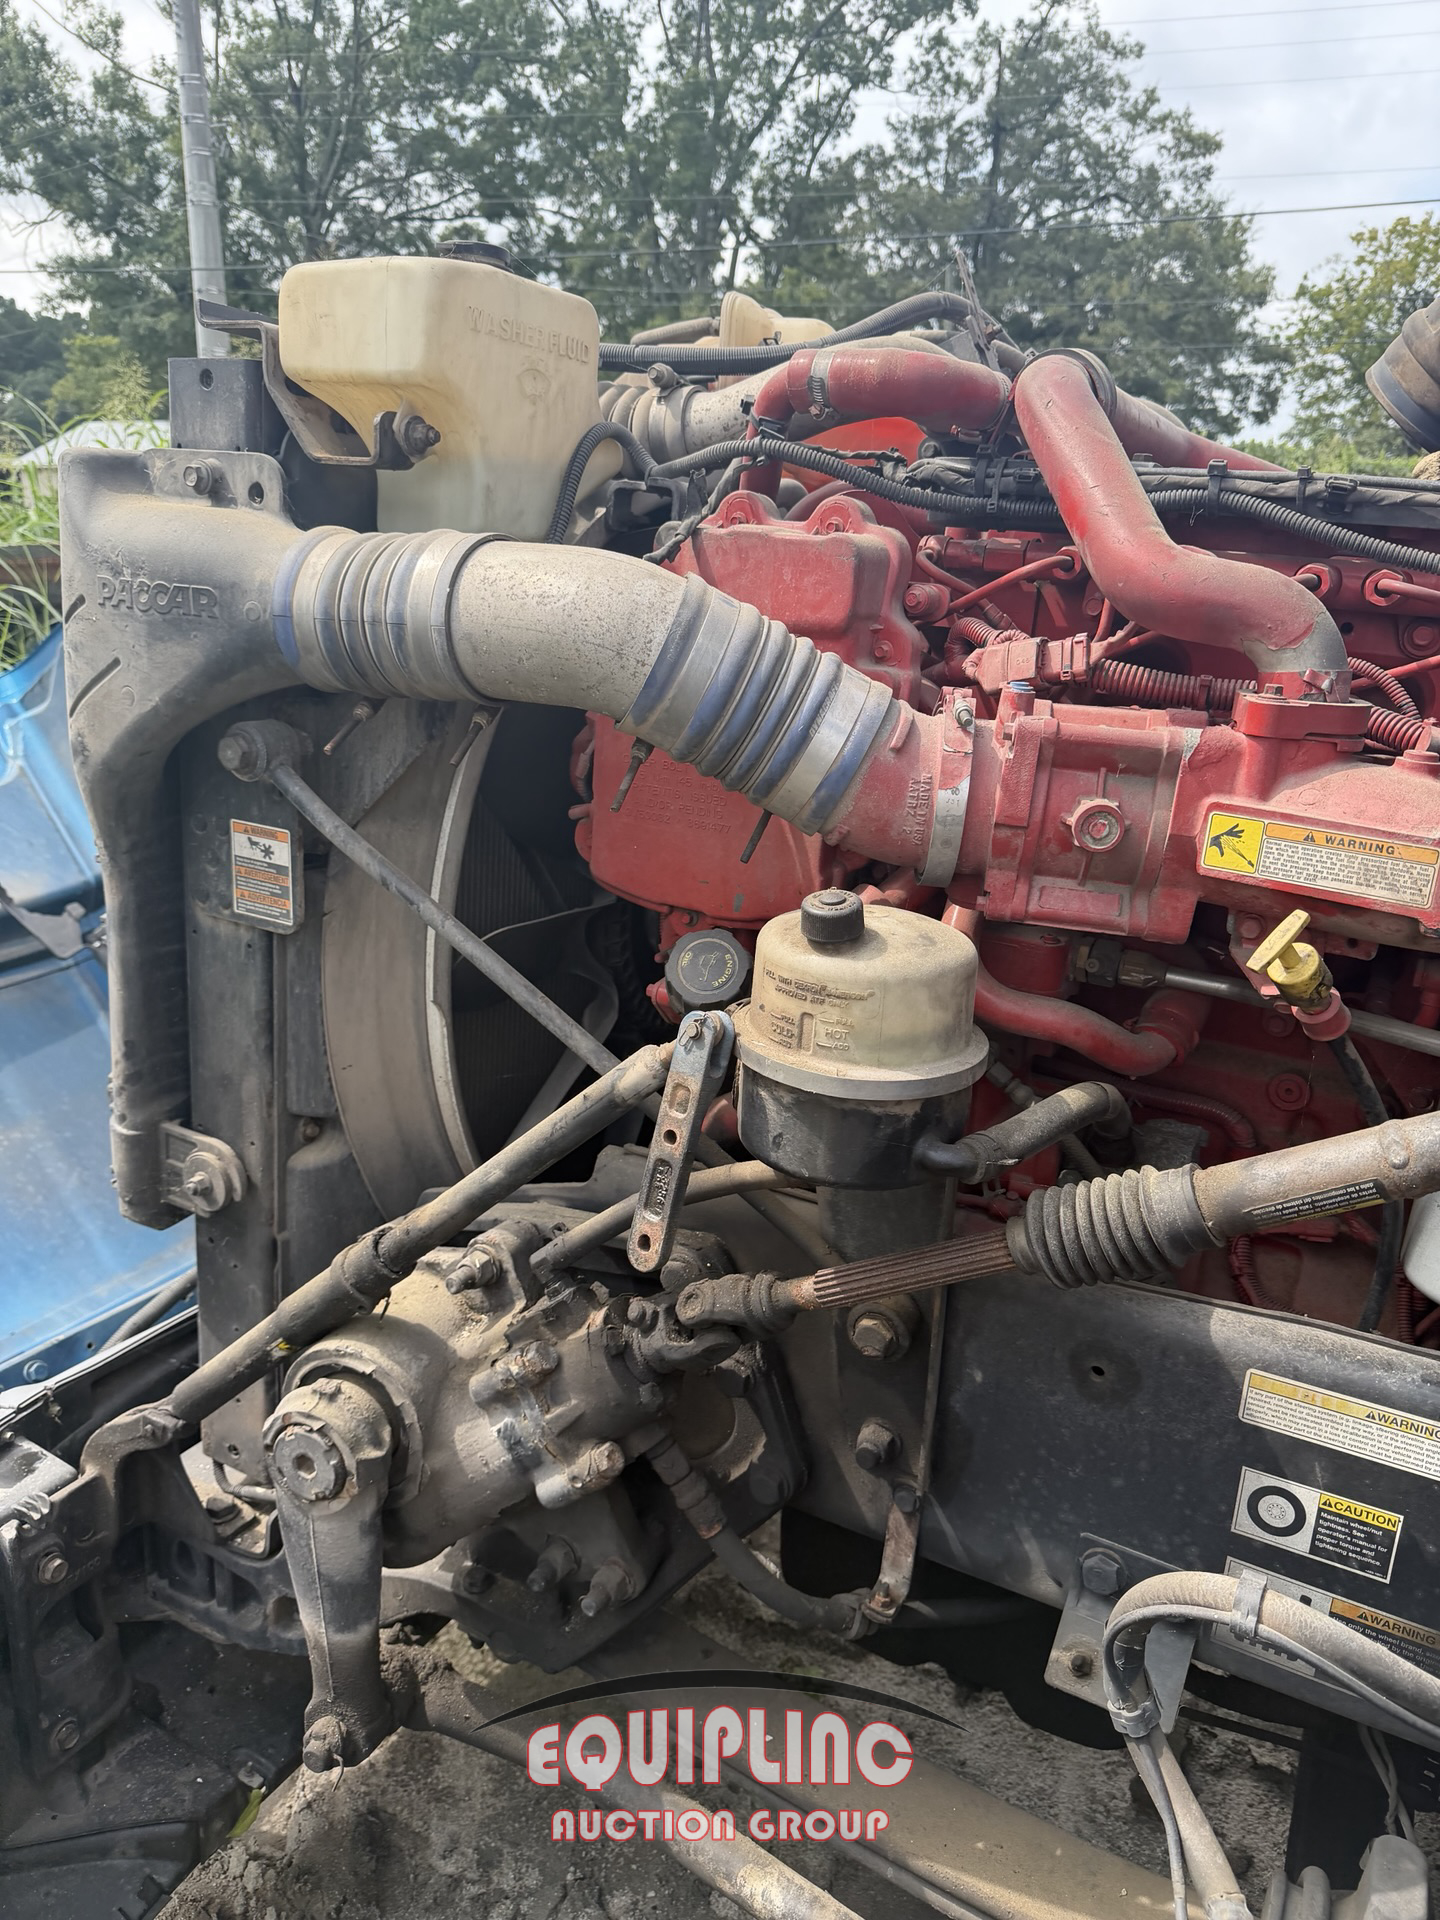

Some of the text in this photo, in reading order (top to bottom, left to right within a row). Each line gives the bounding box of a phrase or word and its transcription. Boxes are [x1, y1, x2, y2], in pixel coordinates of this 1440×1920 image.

[468, 306, 588, 364] WASHER FLUID
[97, 575, 219, 618] PACCAR
[919, 774, 932, 808] MADE
[1325, 835, 1395, 855] WARNING
[682, 952, 692, 968] OIL
[712, 954, 733, 988] ENGINE
[824, 1026, 849, 1040] HOT
[1271, 1413, 1286, 1421] which
[1301, 1422, 1316, 1430] result
[1348, 1436, 1368, 1445] control
[1377, 1445, 1389, 1453] your
[1391, 1449, 1411, 1458] vehicle
[1273, 1402, 1296, 1412] removed
[1305, 1411, 1342, 1426] disassembled
[1400, 1439, 1423, 1450] steering
[1294, 1402, 1316, 1413] steering
[1317, 1409, 1337, 1419] system
[1352, 1419, 1374, 1430] linkage,
[1375, 1426, 1398, 1437] steering
[1400, 1433, 1425, 1445] driveline,
[1245, 1411, 1275, 1424] adjustment
[1323, 1435, 1345, 1446] steering
[1347, 1442, 1367, 1452] system
[1368, 1448, 1382, 1456] must
[1392, 1455, 1422, 1469] performed
[1340, 1428, 1375, 1441] recalibration
[1393, 1443, 1424, 1457] performed
[1318, 1519, 1365, 1537] tightness. See
[1320, 1511, 1348, 1525] Maintain
[1334, 1502, 1396, 1528] CAUTION
[1315, 1534, 1374, 1556] proper torque and
[1317, 1526, 1350, 1541] operator's
[1352, 1537, 1376, 1549] manual
[1314, 1540, 1381, 1567] tightening sequence.
[1347, 1622, 1363, 1633] only
[1365, 1628, 1376, 1636] the
[1378, 1633, 1398, 1644] wheel
[1400, 1641, 1423, 1654] brand,
[1370, 1615, 1436, 1645] WARNING
[1391, 1645, 1413, 1657] by the
